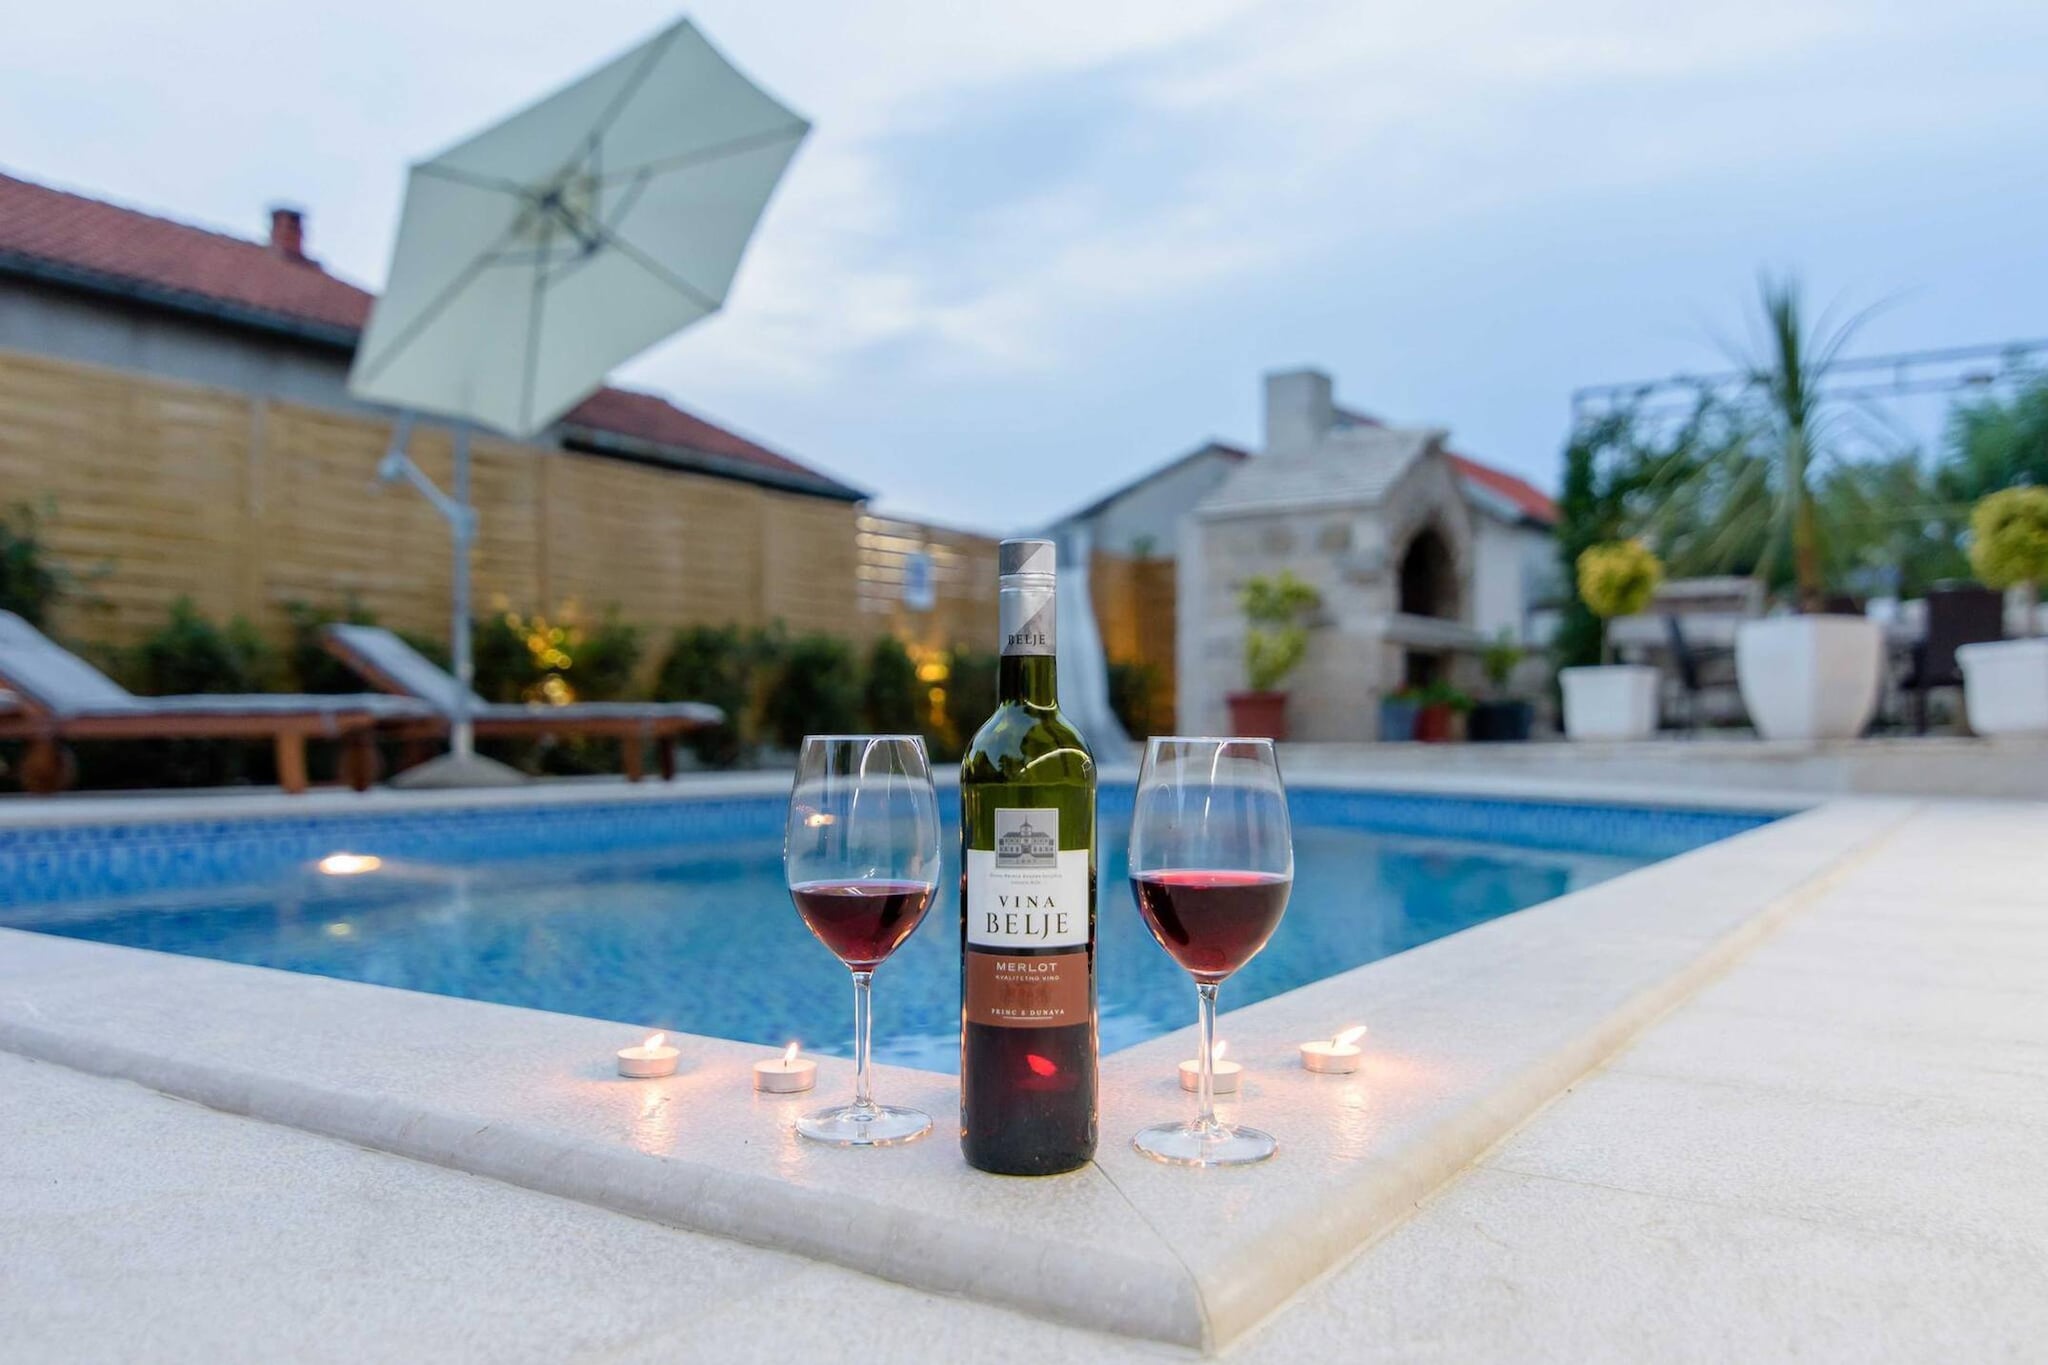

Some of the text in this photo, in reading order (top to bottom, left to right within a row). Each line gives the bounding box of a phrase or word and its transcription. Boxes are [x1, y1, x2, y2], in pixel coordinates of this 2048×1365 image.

[1008, 634, 1046, 647] BELJE
[998, 895, 1055, 908] VINA
[986, 912, 1069, 940] BELJE
[996, 962, 1059, 972] MERLOT
[991, 1008, 1017, 1016] PRINC
[1029, 1008, 1065, 1016] DUNAVA
